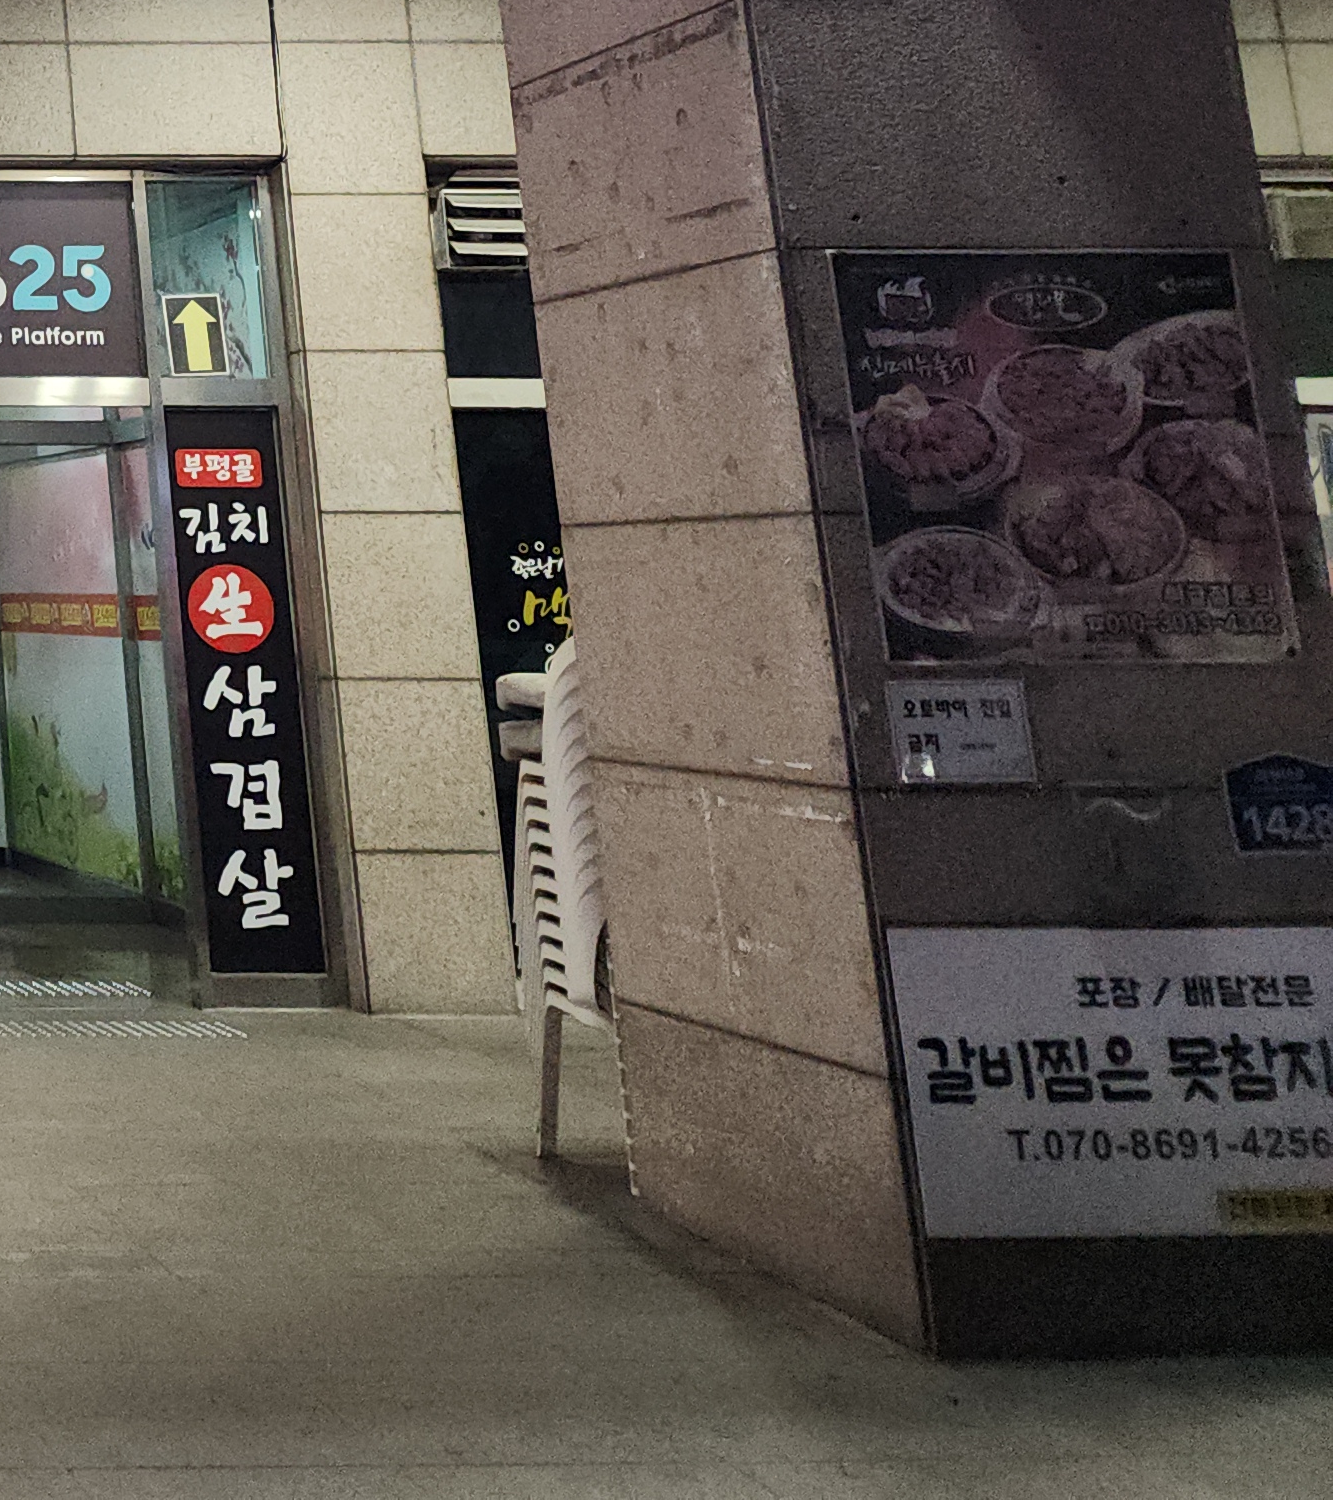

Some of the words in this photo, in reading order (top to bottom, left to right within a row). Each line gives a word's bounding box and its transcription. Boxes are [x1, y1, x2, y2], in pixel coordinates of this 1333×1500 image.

[10, 325, 106, 347] Platform
[860, 354, 976, 386] 신메뉴출시
[182, 453, 256, 484] 부평골
[178, 502, 270, 555] 김치
[198, 571, 264, 639] 生
[903, 699, 969, 718] 오토바이
[978, 699, 1012, 718] 진입
[907, 733, 941, 753] 금지
[202, 665, 294, 930] 삼겹살
[1242, 803, 1333, 843] 1428
[1073, 974, 1140, 1009] 포장
[1182, 974, 1316, 1009] 배달전문
[917, 1035, 1153, 1104] 갈비찜은
[1167, 1033, 1333, 1104] 못참지
